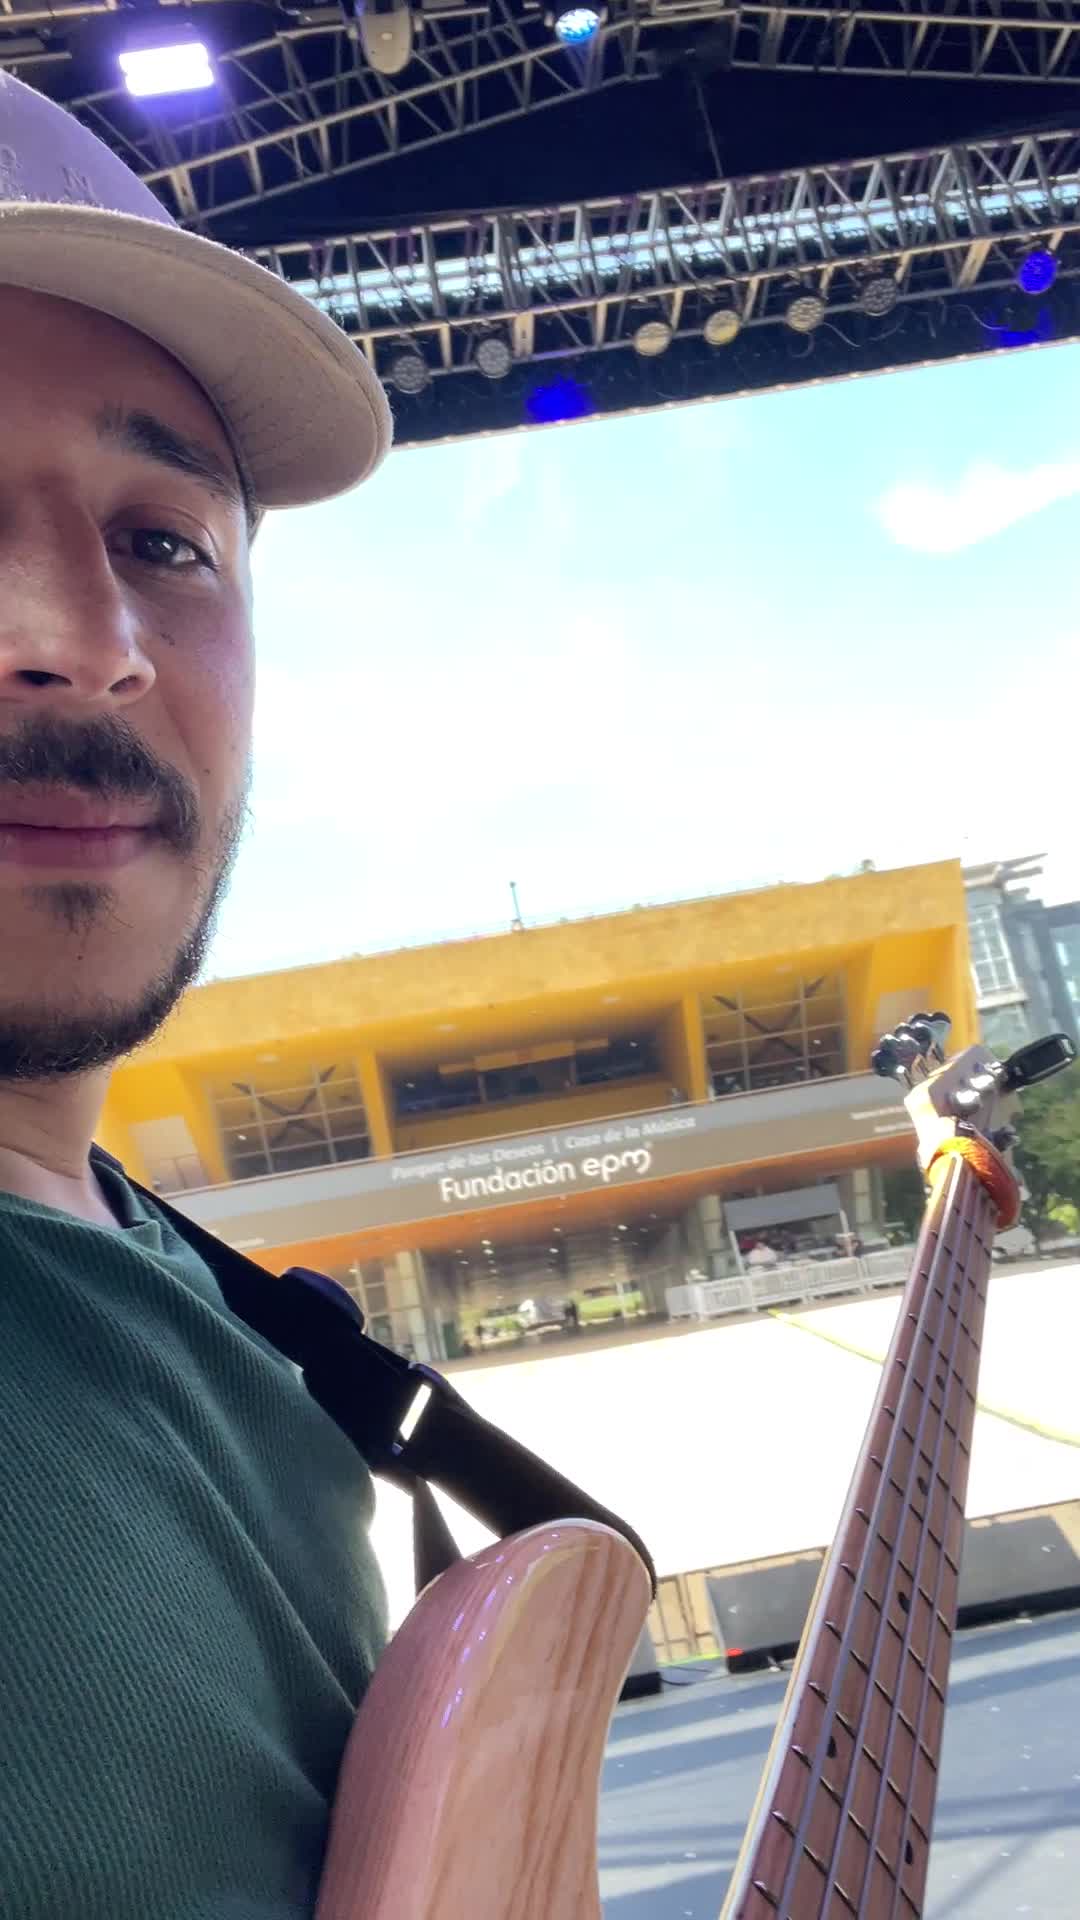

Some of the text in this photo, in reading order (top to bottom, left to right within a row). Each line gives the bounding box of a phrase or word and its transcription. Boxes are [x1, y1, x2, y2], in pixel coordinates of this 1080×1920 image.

[447, 1155, 465, 1169] de
[469, 1152, 491, 1165] los
[494, 1144, 544, 1161] Deseos
[566, 1134, 600, 1148] Casa
[604, 1128, 622, 1142] de
[624, 1126, 640, 1138] la
[440, 1148, 651, 1202] Fundación epm
